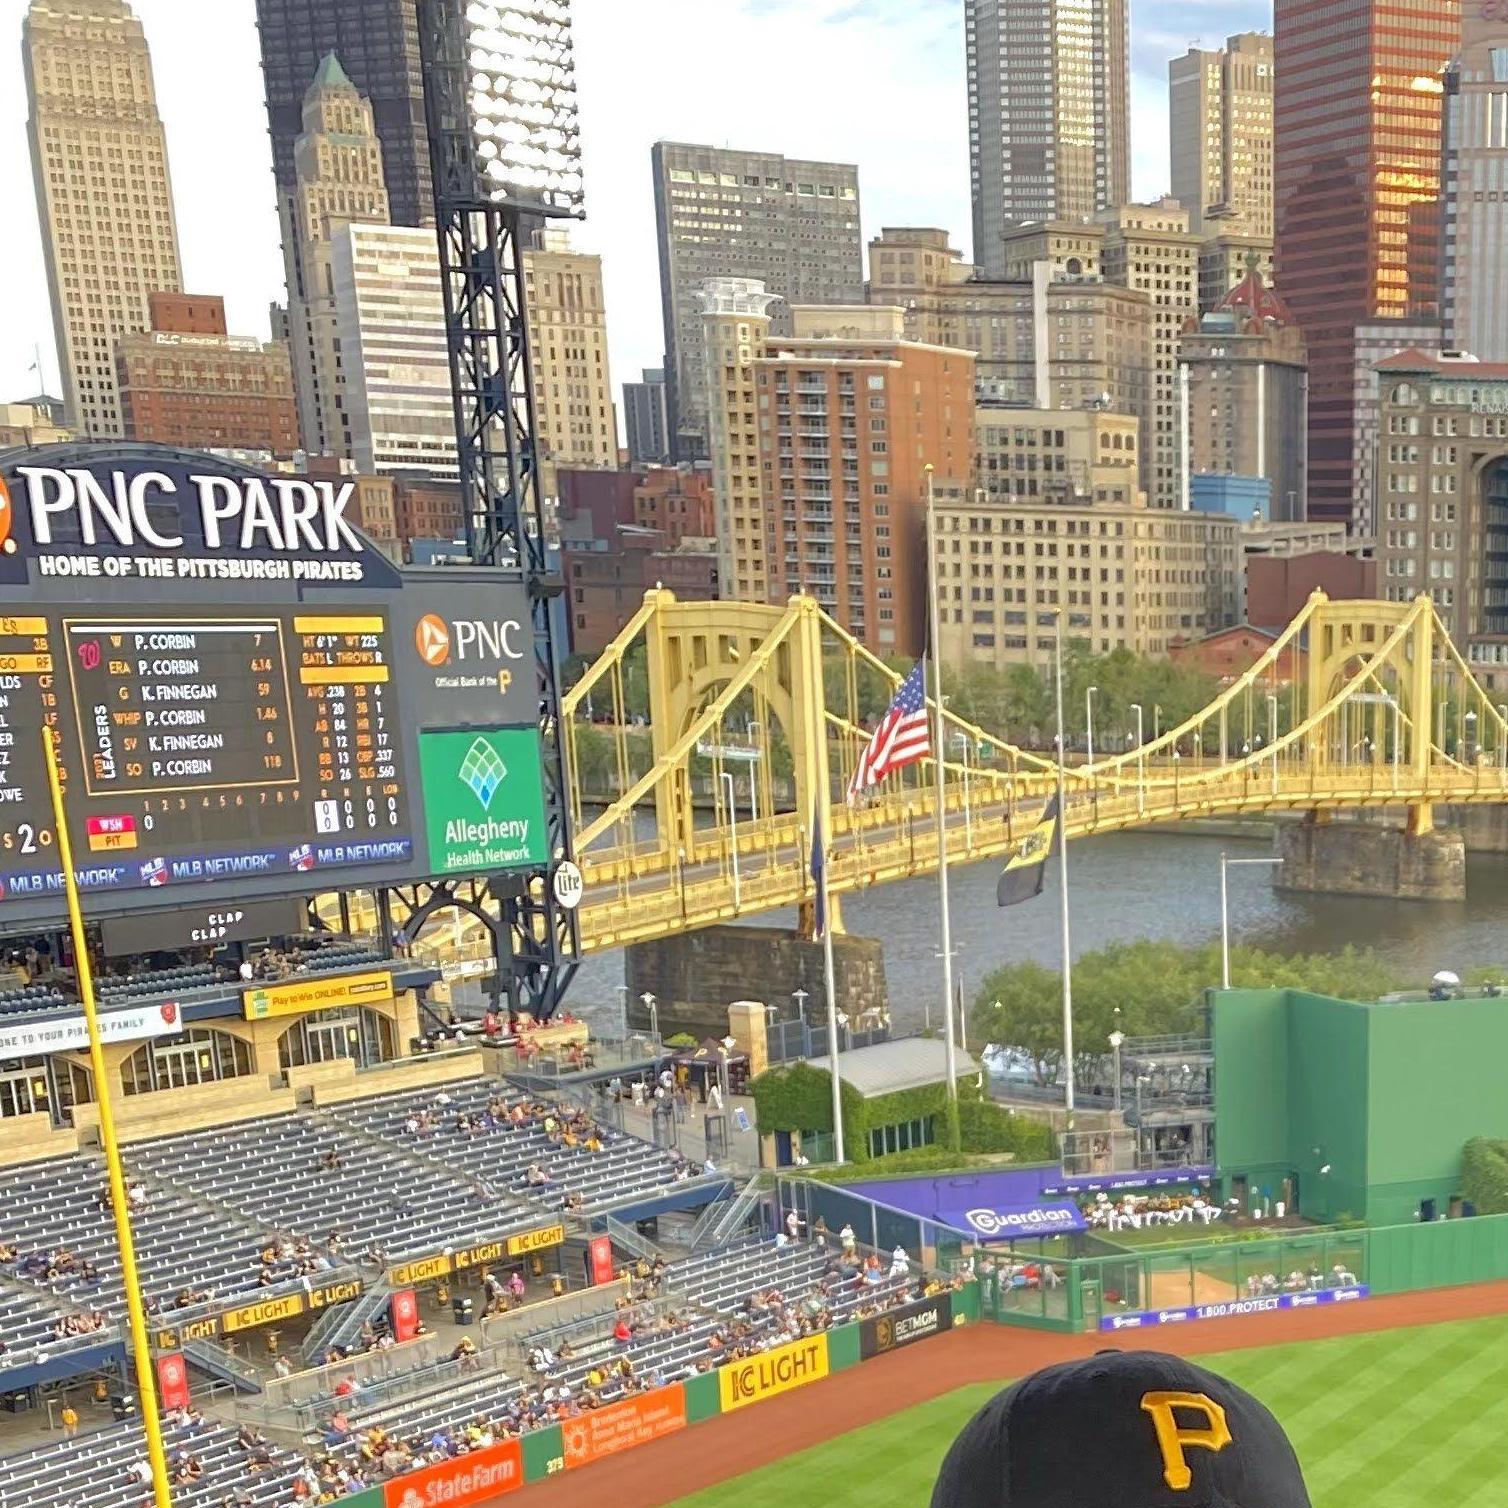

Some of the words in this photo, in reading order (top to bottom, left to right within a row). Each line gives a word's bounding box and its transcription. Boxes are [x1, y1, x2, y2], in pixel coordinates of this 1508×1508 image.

[16, 466, 183, 547] PNC
[190, 475, 363, 551] PARK
[39, 556, 100, 576] HOME
[103, 556, 131, 576] OF
[135, 557, 177, 577] THE
[179, 558, 289, 579] PITTSBURGH
[293, 560, 363, 581] PIRATES
[150, 634, 195, 649] CORBIN
[452, 620, 523, 659] PNC
[108, 661, 131, 674] ERA
[152, 660, 199, 675] CORBIN
[157, 684, 217, 701] FINNEGAN
[160, 710, 205, 726] CORBIN
[95, 705, 116, 779] LEADERS
[163, 734, 223, 751] FINNEGAN
[167, 759, 212, 775] CORBIN
[17, 823, 37, 854] 2
[445, 817, 529, 846] Allegheny
[318, 846, 343, 862] MLB
[346, 841, 404, 860] NETWORK
[447, 850, 483, 867] Health
[485, 845, 530, 863] Network
[172, 860, 201, 877] MLB
[205, 854, 270, 875] NETWORK
[10, 872, 43, 893] MLB
[46, 868, 119, 890] NEWORK
[558, 872, 580, 896] Lite
[209, 911, 243, 926] CLAP
[192, 926, 226, 941] CLAP
[67, 1024, 108, 1039] PIRAES
[111, 1017, 145, 1032] FAMILY
[976, 1208, 1073, 1228] Guardian
[533, 1228, 562, 1246] LIGHT
[471, 1243, 502, 1263] LIGHT
[326, 1280, 361, 1303] LIGHT
[254, 1300, 290, 1322] LIGHT
[896, 1309, 938, 1336] BETMGM
[731, 1365, 755, 1402] IC
[760, 1345, 819, 1391] LIGHT
[1141, 1391, 1233, 1490] P
